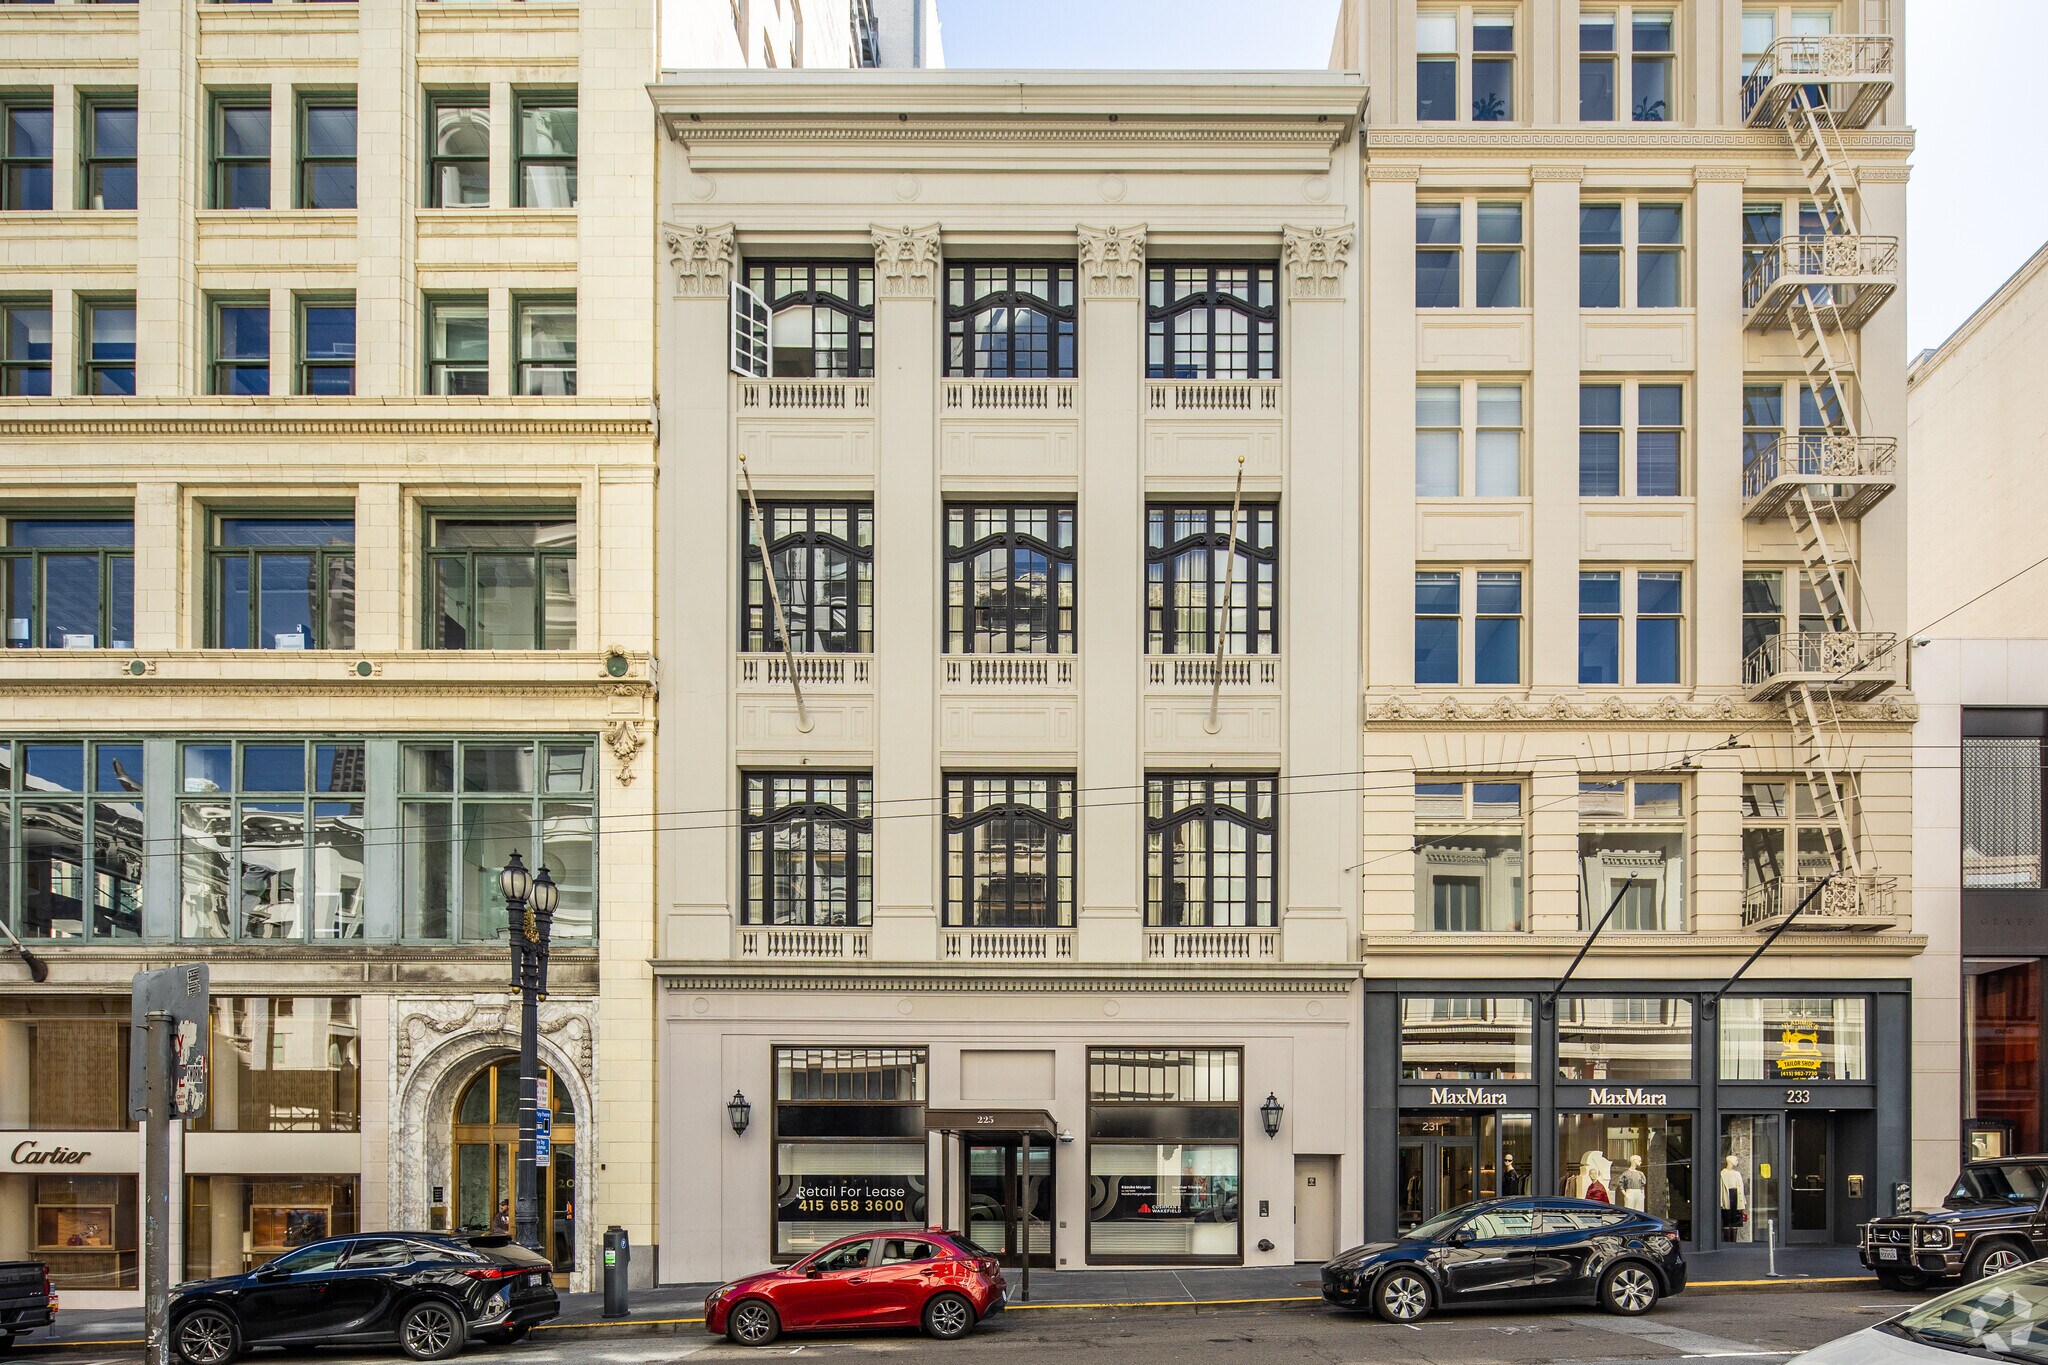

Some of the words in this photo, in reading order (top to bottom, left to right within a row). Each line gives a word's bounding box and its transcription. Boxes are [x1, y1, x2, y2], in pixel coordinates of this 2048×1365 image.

[1430, 1088, 1507, 1105] MaxMara
[1589, 1088, 1667, 1105] MaxMara
[1787, 1090, 1810, 1103] 233
[977, 1115, 994, 1124] 225
[1422, 1122, 1439, 1131] 231
[11, 1141, 91, 1164] Cartier
[798, 1186, 836, 1197] Retail
[841, 1187, 861, 1197] For
[866, 1187, 905, 1197] Lease
[798, 1200, 824, 1212] 415
[830, 1200, 859, 1212] 658
[865, 1200, 904, 1212] 3600
